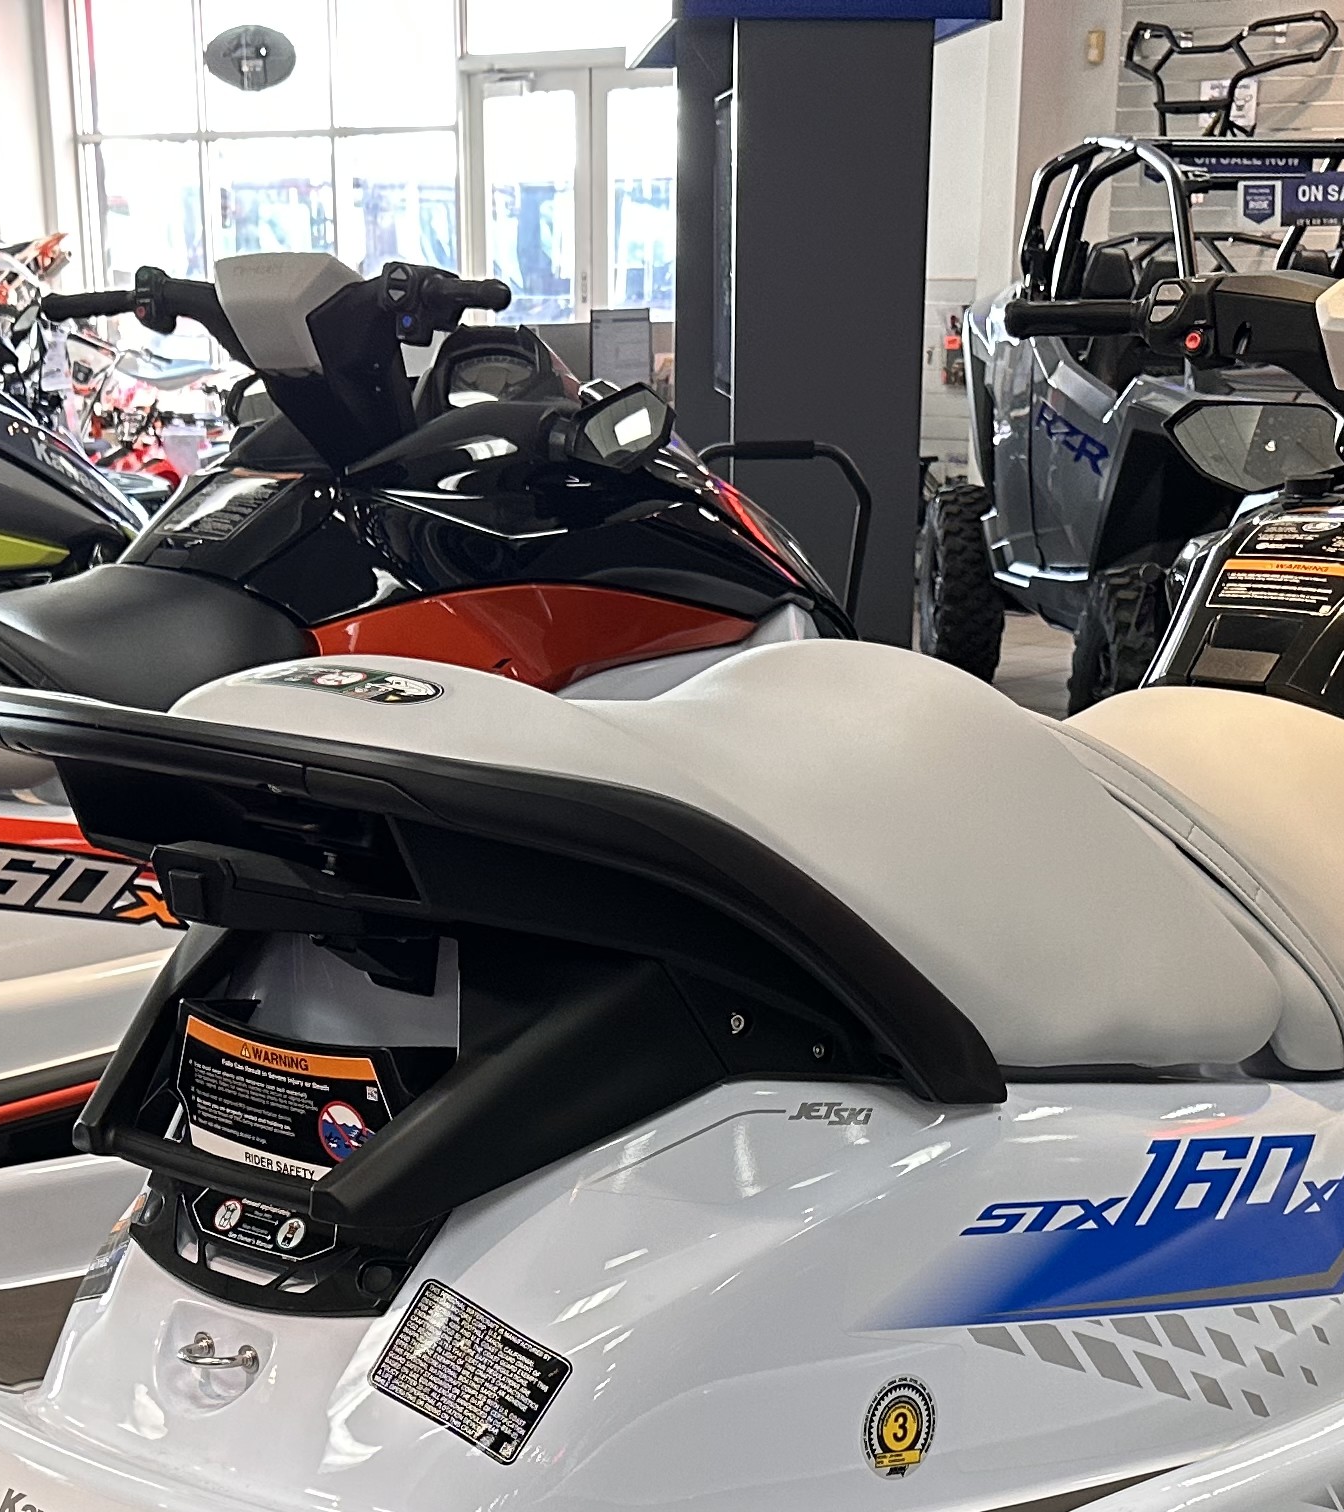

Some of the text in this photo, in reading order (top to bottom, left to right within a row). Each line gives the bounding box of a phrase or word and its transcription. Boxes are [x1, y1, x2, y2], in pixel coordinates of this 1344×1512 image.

[1297, 185, 1324, 202] ON
[1036, 402, 1110, 477] RZR
[251, 1045, 309, 1071] WARNING
[244, 1152, 315, 1180] RIDER SAFETY
[891, 1411, 909, 1443] 3
